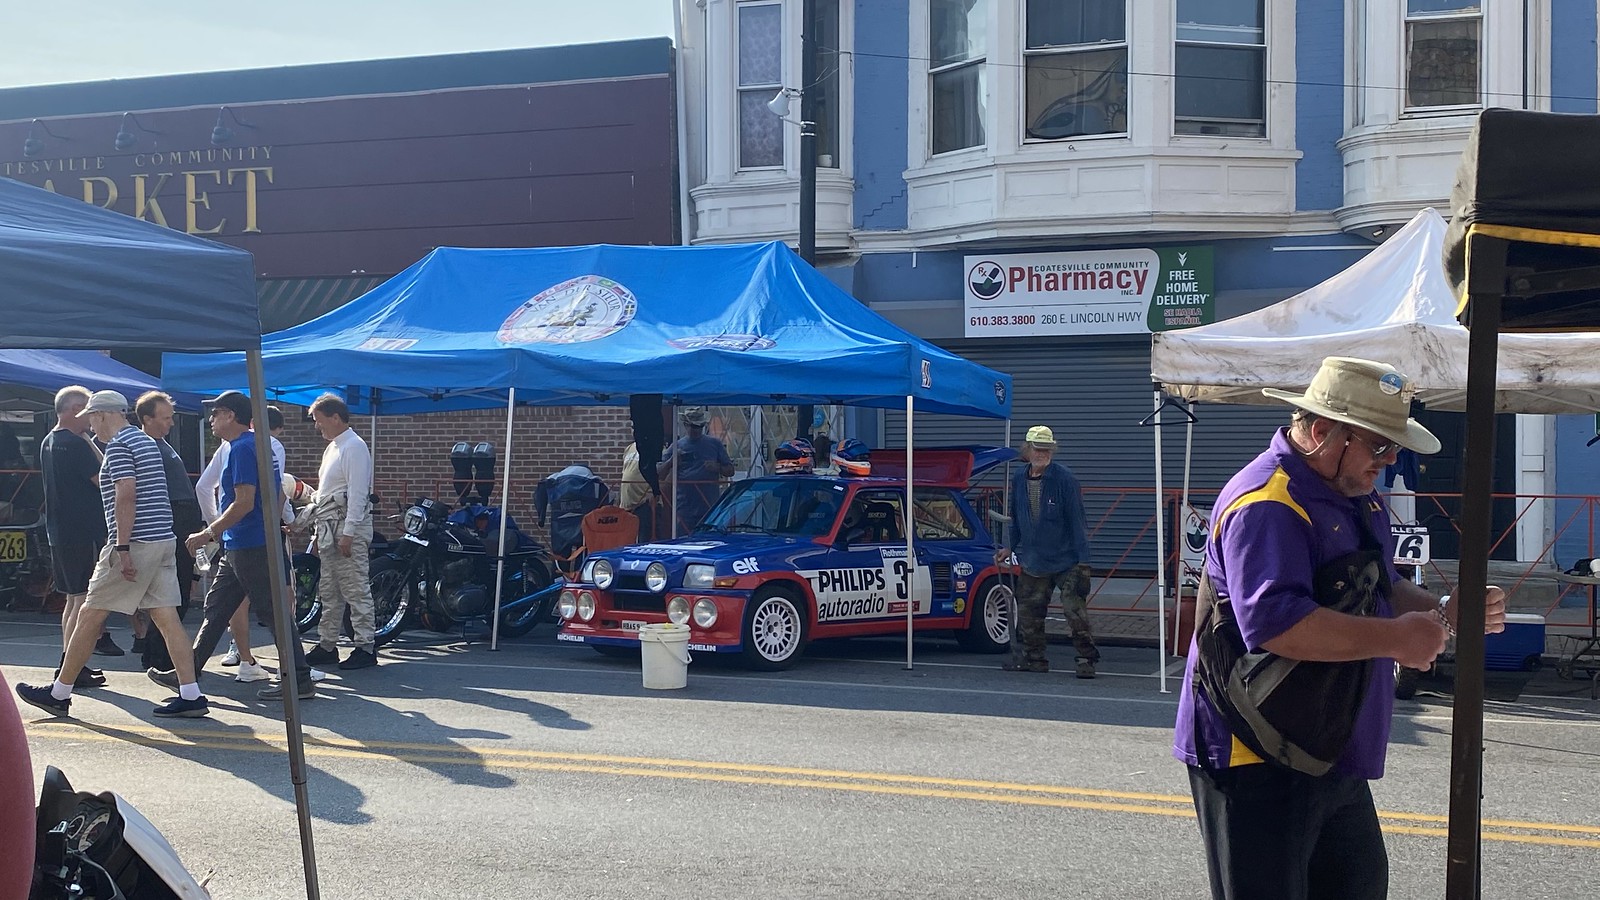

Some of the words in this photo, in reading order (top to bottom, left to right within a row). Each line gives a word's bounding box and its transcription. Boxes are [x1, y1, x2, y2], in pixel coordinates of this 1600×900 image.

[3, 156, 105, 175] TESVILLE
[135, 146, 273, 167] COMMUNITY
[43, 166, 274, 235] RKET
[1034, 264, 1091, 272] COATESVILLE
[1094, 261, 1150, 270] COMMUNITY
[1169, 270, 1195, 281] FREE
[1009, 267, 1149, 295] Pharmacy
[1166, 282, 1199, 293] HOME
[970, 315, 1036, 327] 610.383.3800
[1041, 314, 1057, 325] 260
[1059, 314, 1068, 324] E.
[1070, 313, 1114, 324] LINCOLN
[1117, 312, 1142, 322] HWY
[0, 538, 25, 560] 263
[882, 549, 909, 558] Rothma
[732, 556, 761, 574] elf
[818, 568, 886, 593] PHILIPS
[818, 593, 884, 620] autoradio
[687, 643, 716, 652] CHELIN
